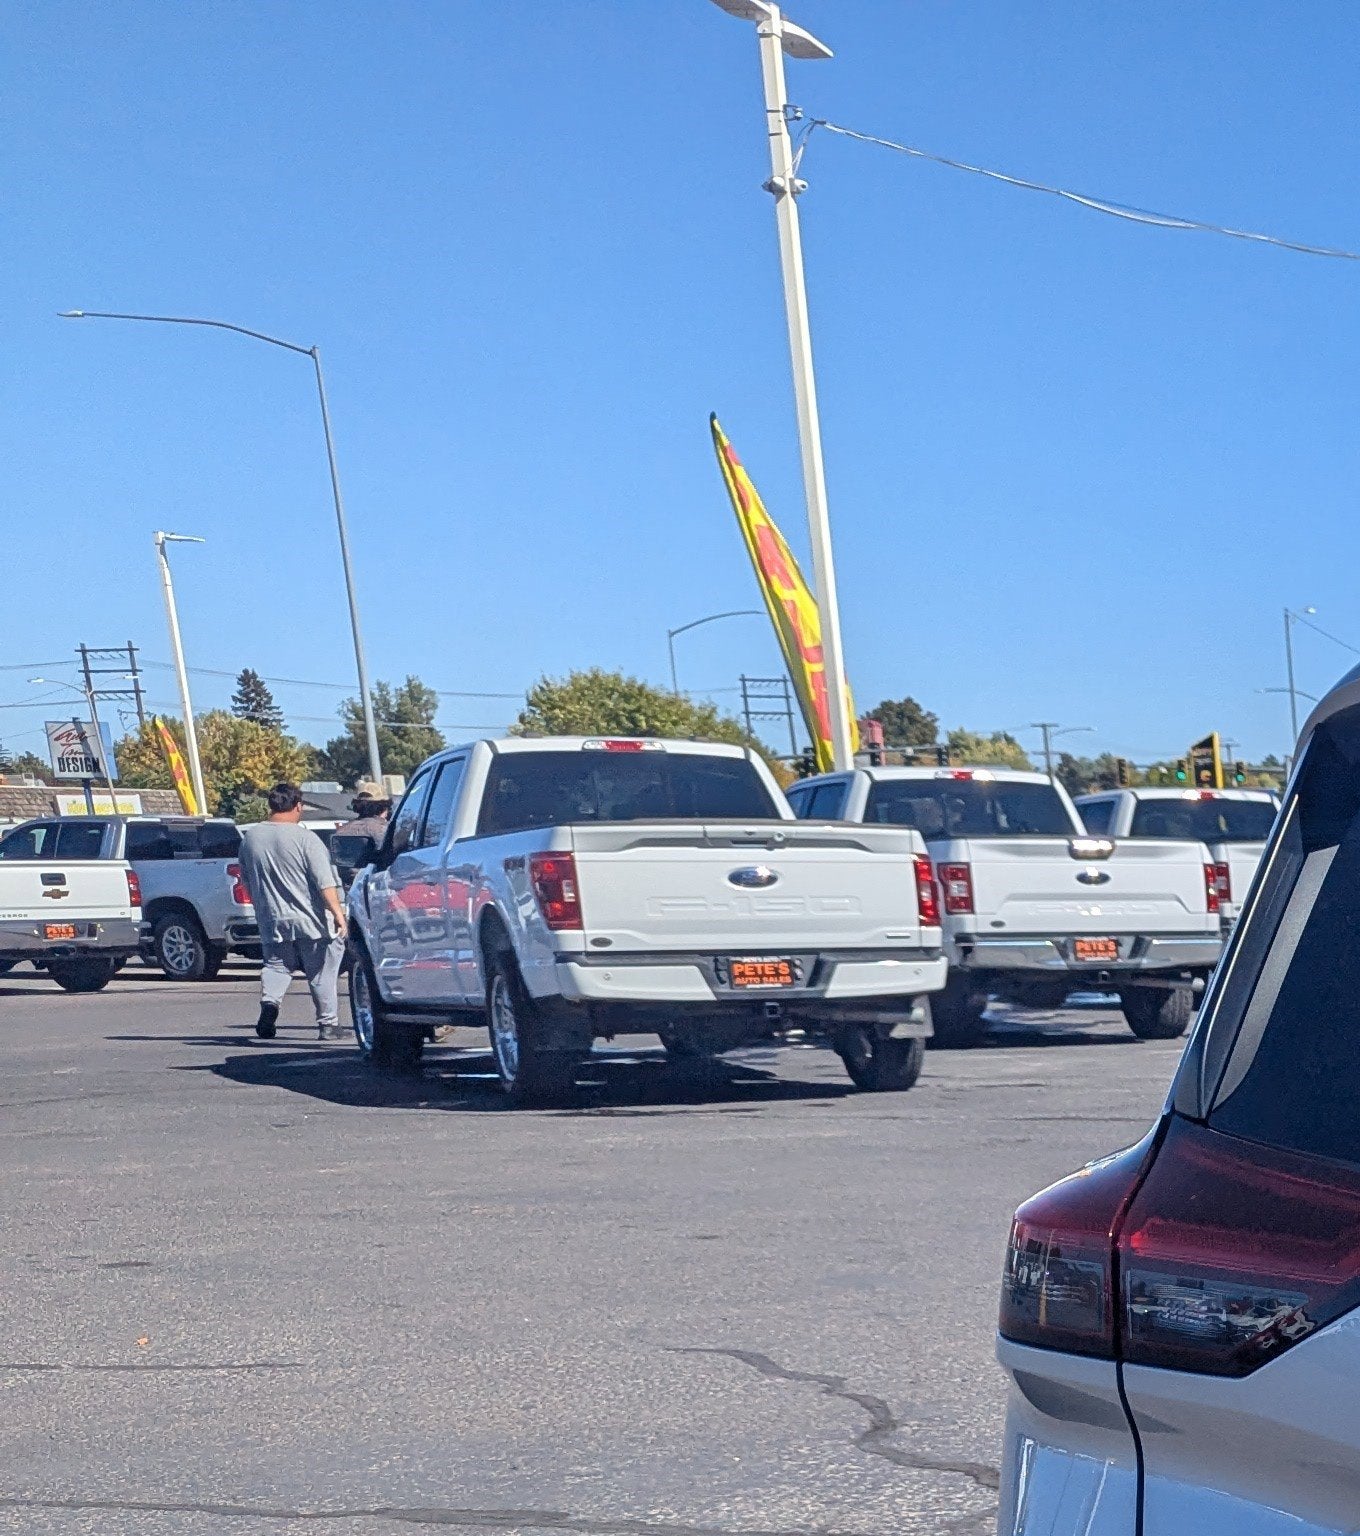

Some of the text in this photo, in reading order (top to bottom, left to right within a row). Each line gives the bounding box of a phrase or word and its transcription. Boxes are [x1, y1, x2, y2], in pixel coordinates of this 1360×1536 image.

[57, 757, 102, 773] DESIGN
[646, 895, 863, 917] F-150
[1075, 940, 1117, 951] PETE'S
[732, 962, 790, 976] PETE'S
